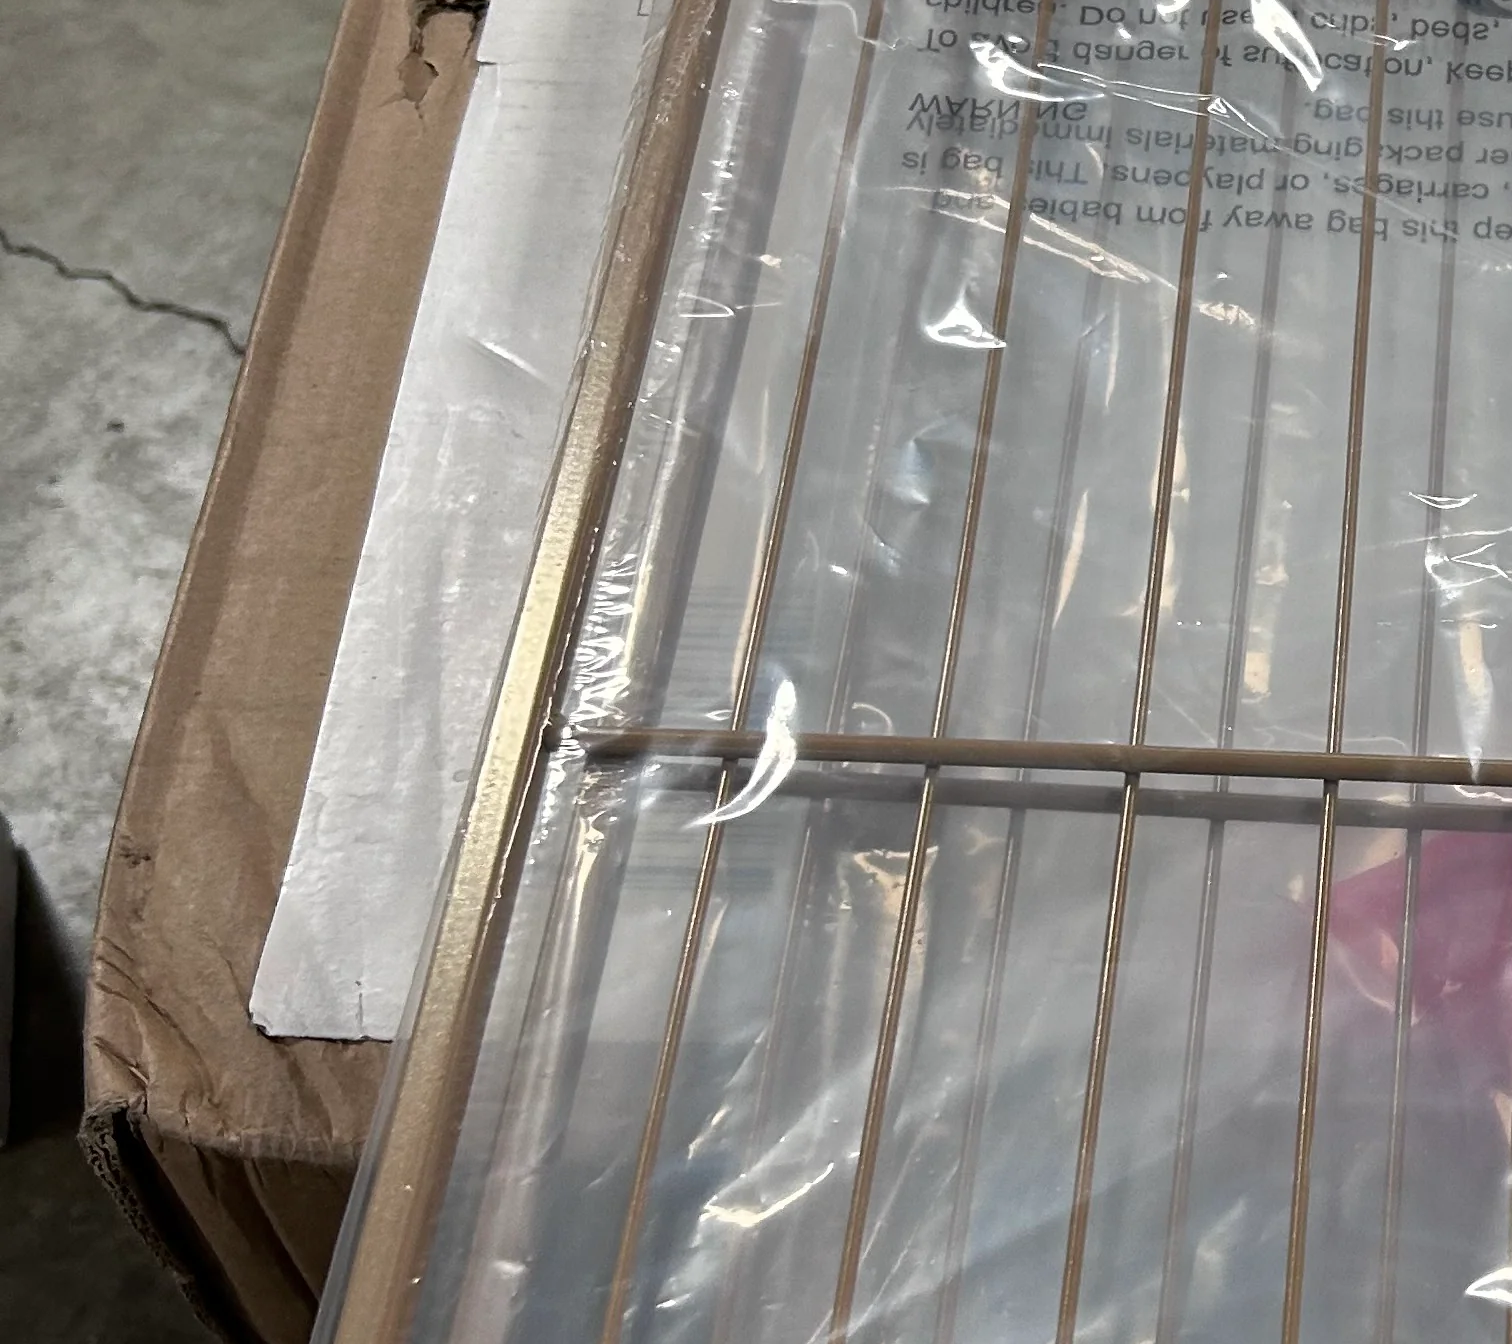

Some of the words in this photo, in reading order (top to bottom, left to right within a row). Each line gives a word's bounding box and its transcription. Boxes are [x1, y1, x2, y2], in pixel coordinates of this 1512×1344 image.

[906, 116, 1112, 149] immdiately
[1387, 107, 1444, 131] this
[901, 153, 928, 174] is
[942, 146, 1003, 179] bag
[1292, 133, 1464, 166] packging
[1276, 173, 1309, 192] or
[1322, 172, 1490, 203] carriages,
[1137, 209, 1212, 233] fom
[1222, 205, 1313, 234] away
[1326, 209, 1388, 241] bag
[1402, 219, 1460, 244] this
